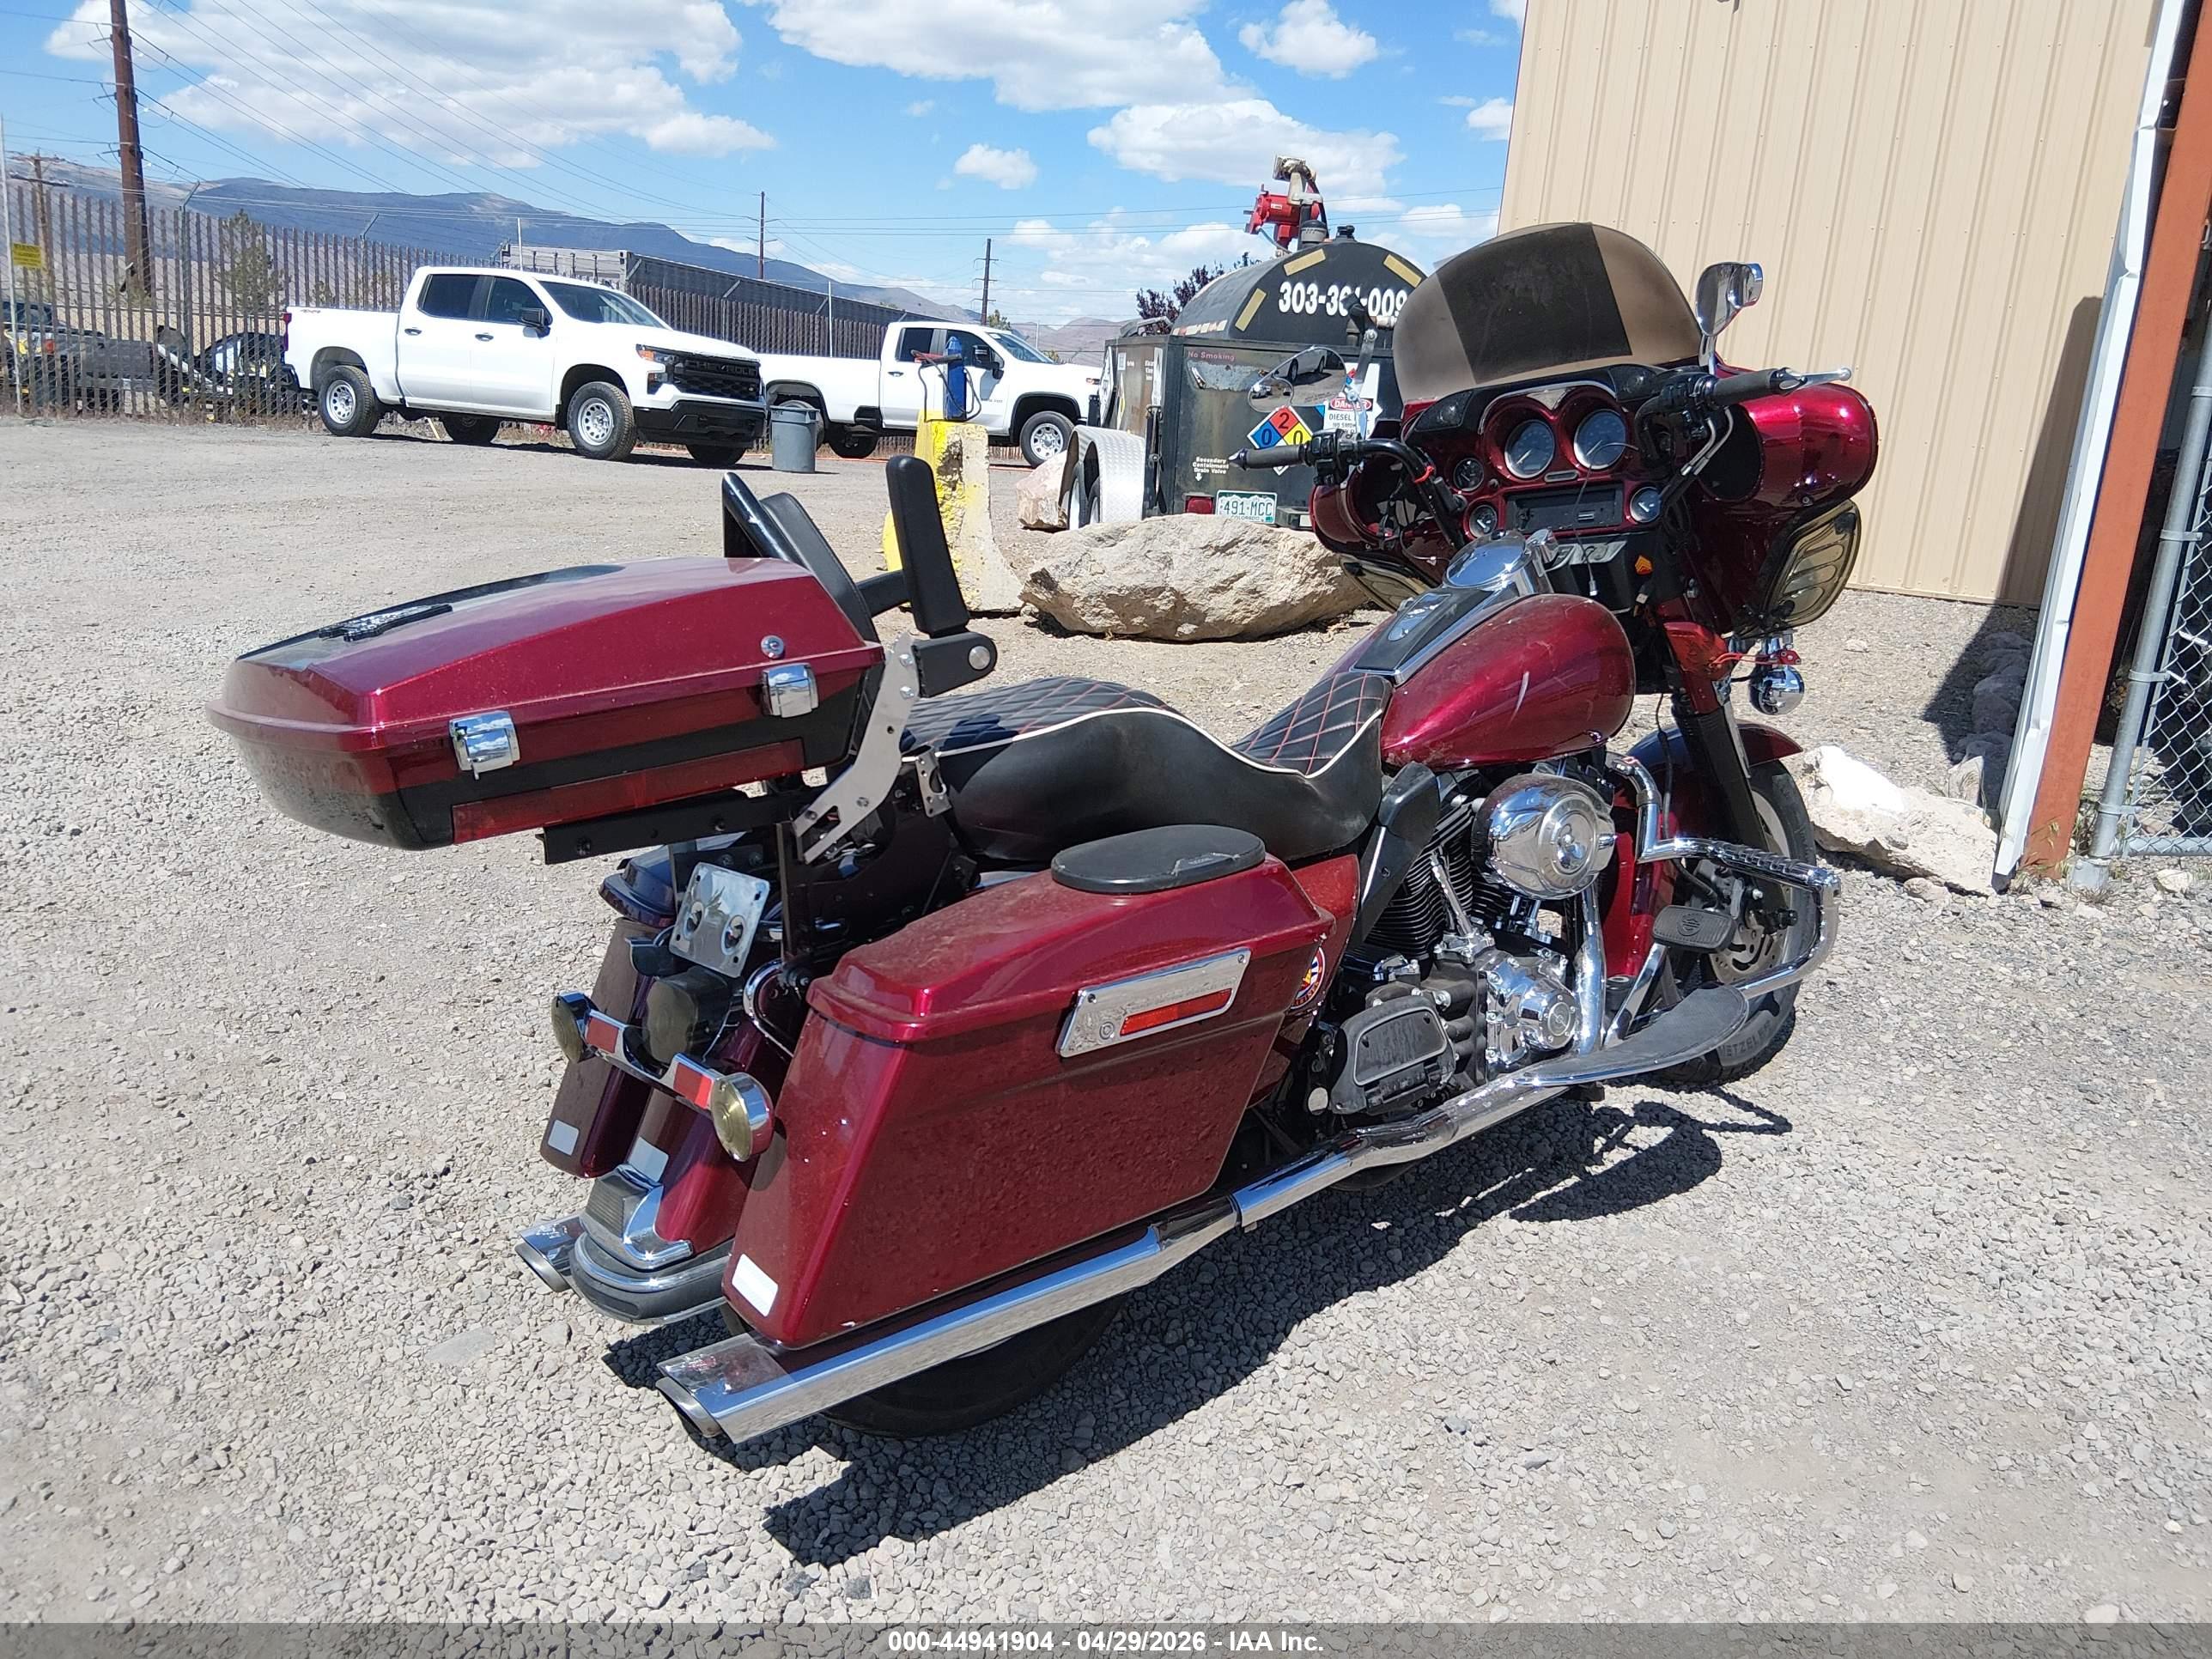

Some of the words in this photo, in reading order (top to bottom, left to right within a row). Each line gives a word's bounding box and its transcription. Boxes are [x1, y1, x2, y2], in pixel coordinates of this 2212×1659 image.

[1200, 351, 1235, 362] Smoking
[1278, 411, 1290, 429] 2
[1261, 428, 1273, 446] 0
[1292, 429, 1304, 446] 0
